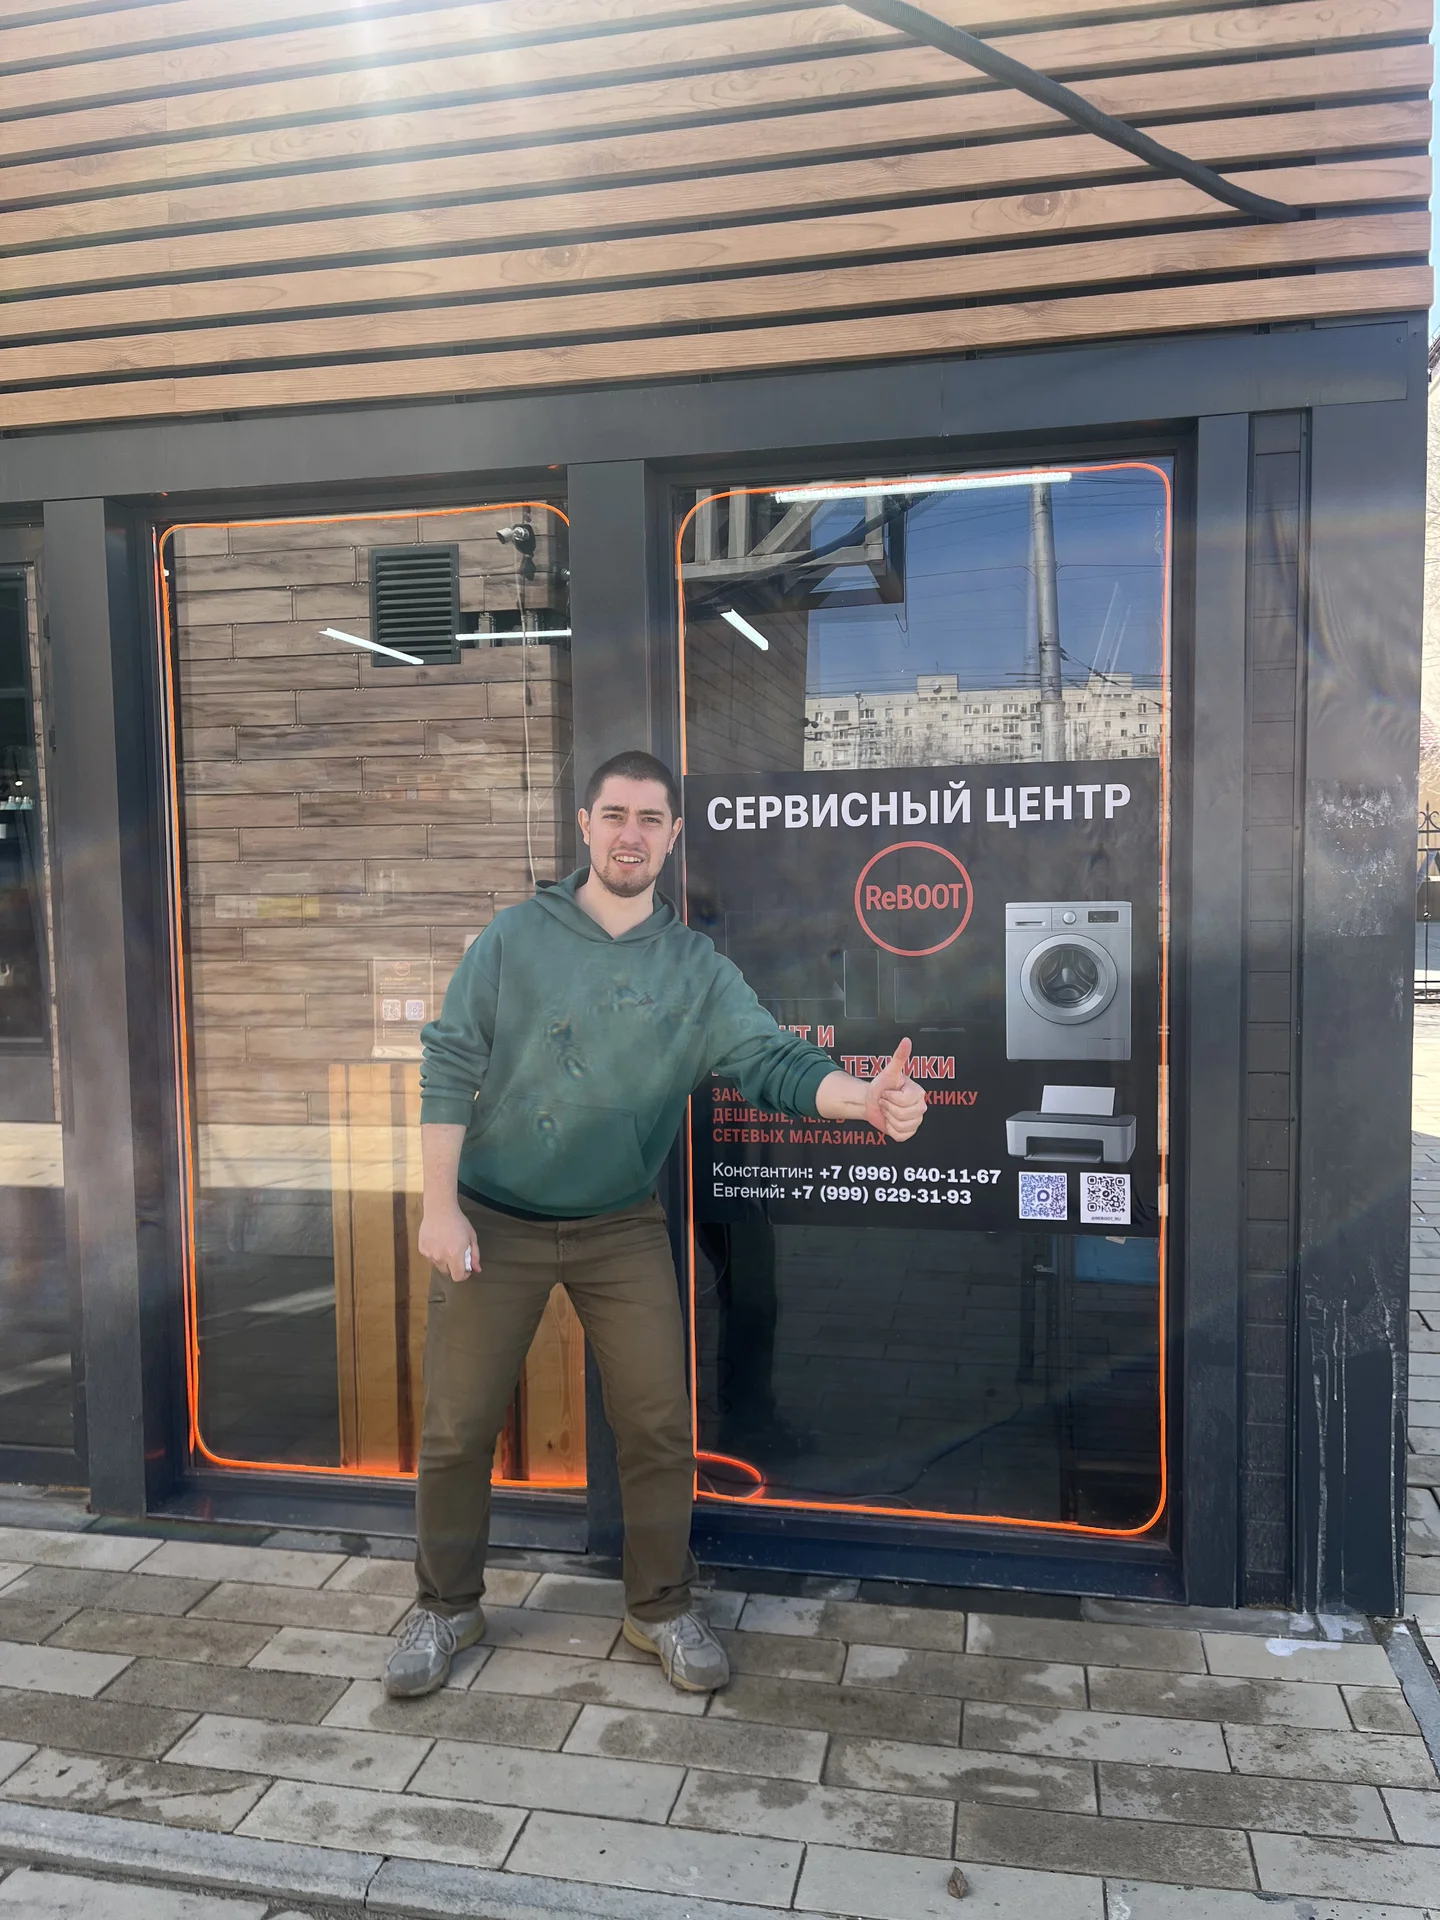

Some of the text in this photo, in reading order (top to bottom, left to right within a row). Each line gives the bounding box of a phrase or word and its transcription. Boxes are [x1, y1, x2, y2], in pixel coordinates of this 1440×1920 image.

[706, 780, 1132, 831] СЕРВИСНЫЙ ЦЕНТР
[865, 883, 964, 911] ReBOOT
[817, 1024, 835, 1048] И
[840, 1055, 956, 1079] ТЕХИКИ
[712, 1128, 888, 1145] СЕТЕВЫХ МАГАЗИНАХ
[712, 1162, 1002, 1184] Константин: +7 (996) 640-11-67
[713, 1182, 972, 1204] Евгений: +7 (999) 629-31-93
